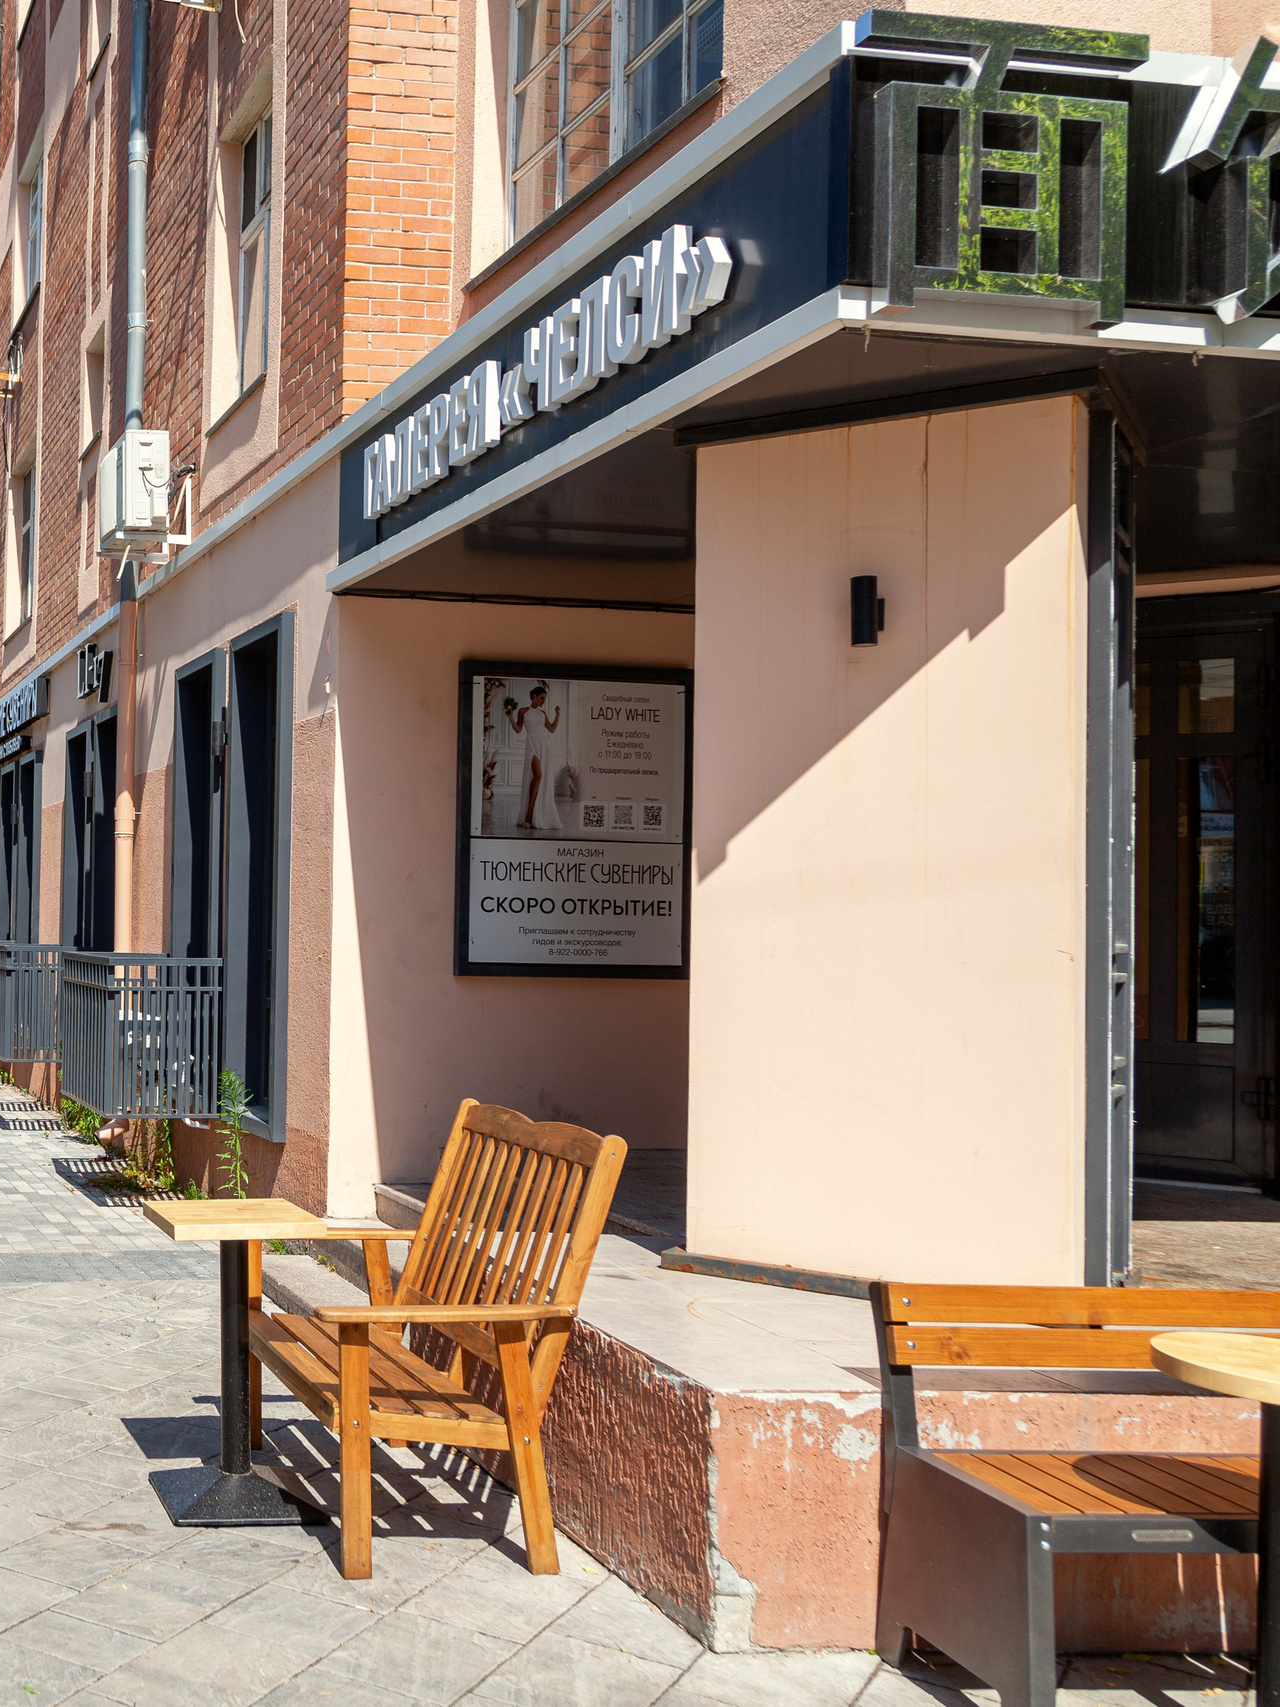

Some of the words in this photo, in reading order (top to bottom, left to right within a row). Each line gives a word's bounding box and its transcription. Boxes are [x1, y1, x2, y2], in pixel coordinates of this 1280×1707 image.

[363, 360, 501, 520] ГАЛЕРЕЯ
[499, 224, 733, 427] «ЧЕЛСИ»
[602, 694, 632, 703] Свадебный
[590, 706, 622, 720] LADY
[625, 708, 660, 723] WHITE
[601, 728, 623, 737] Режим
[625, 730, 650, 739] работы
[607, 739, 644, 749] Ежедневно
[605, 750, 622, 759] 11:00
[623, 752, 632, 760] до
[634, 751, 652, 760] 19:00
[598, 767, 641, 775] предварительной
[557, 848, 604, 858] МАГАЗИН
[480, 861, 586, 883] ТЮМЕНСКИЕ
[590, 863, 674, 885] СУВЕНИРЫ
[480, 896, 555, 914] СКОРО
[561, 898, 672, 917] ОТКРЫТИЕ!
[518, 927, 568, 936] Приглашаем
[577, 929, 636, 938] сотрудничеству
[564, 939, 623, 947] экскурсоводов:
[548, 948, 608, 956] 8-922-0000-766
